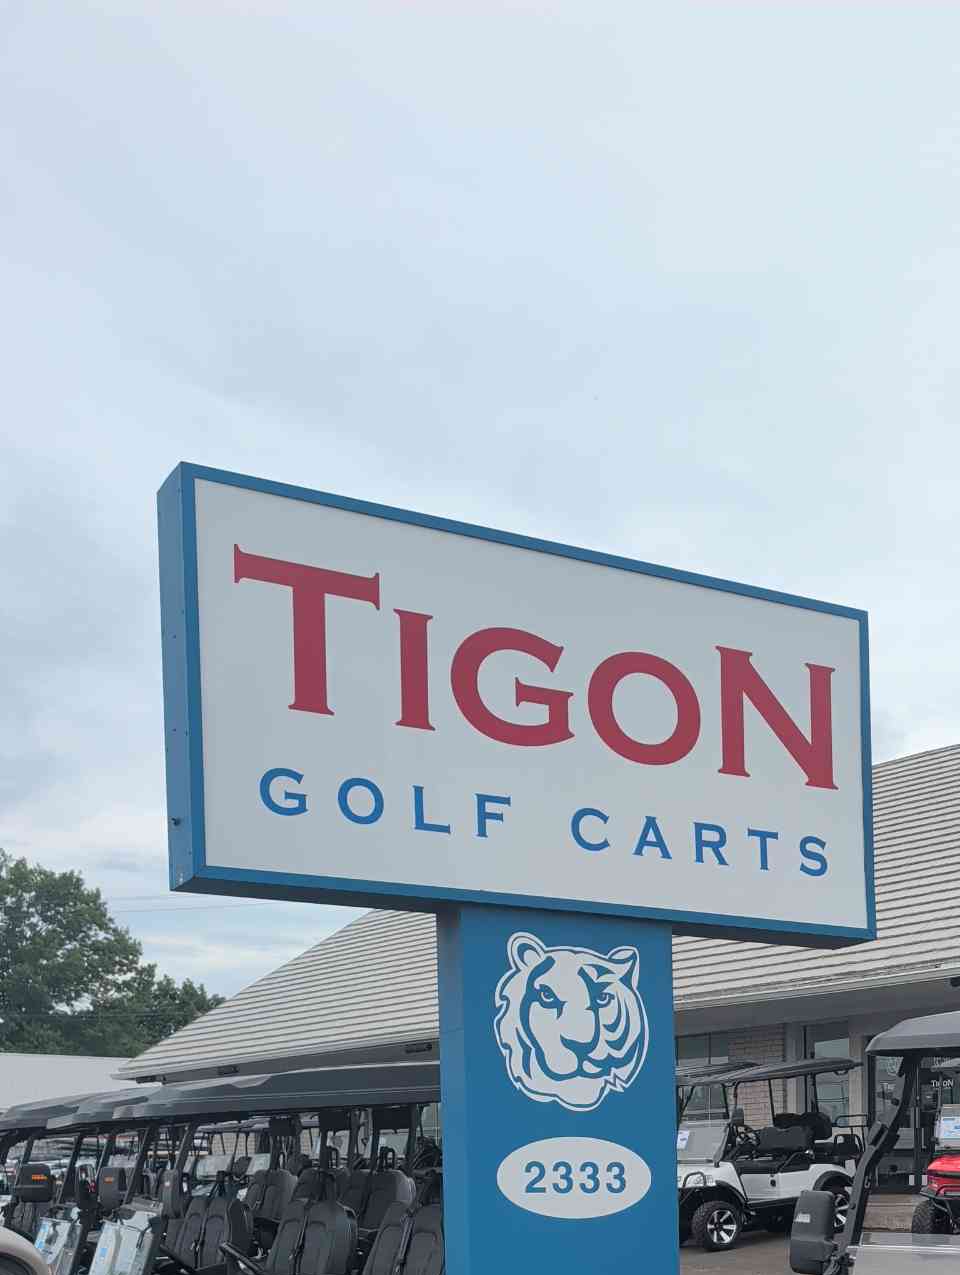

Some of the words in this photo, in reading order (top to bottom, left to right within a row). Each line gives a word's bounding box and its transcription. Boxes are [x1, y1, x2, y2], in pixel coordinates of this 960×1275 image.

[234, 545, 836, 790] TIGON
[259, 768, 511, 838] GOLF
[570, 808, 828, 877] CARTS
[525, 1160, 626, 1196] 2333
